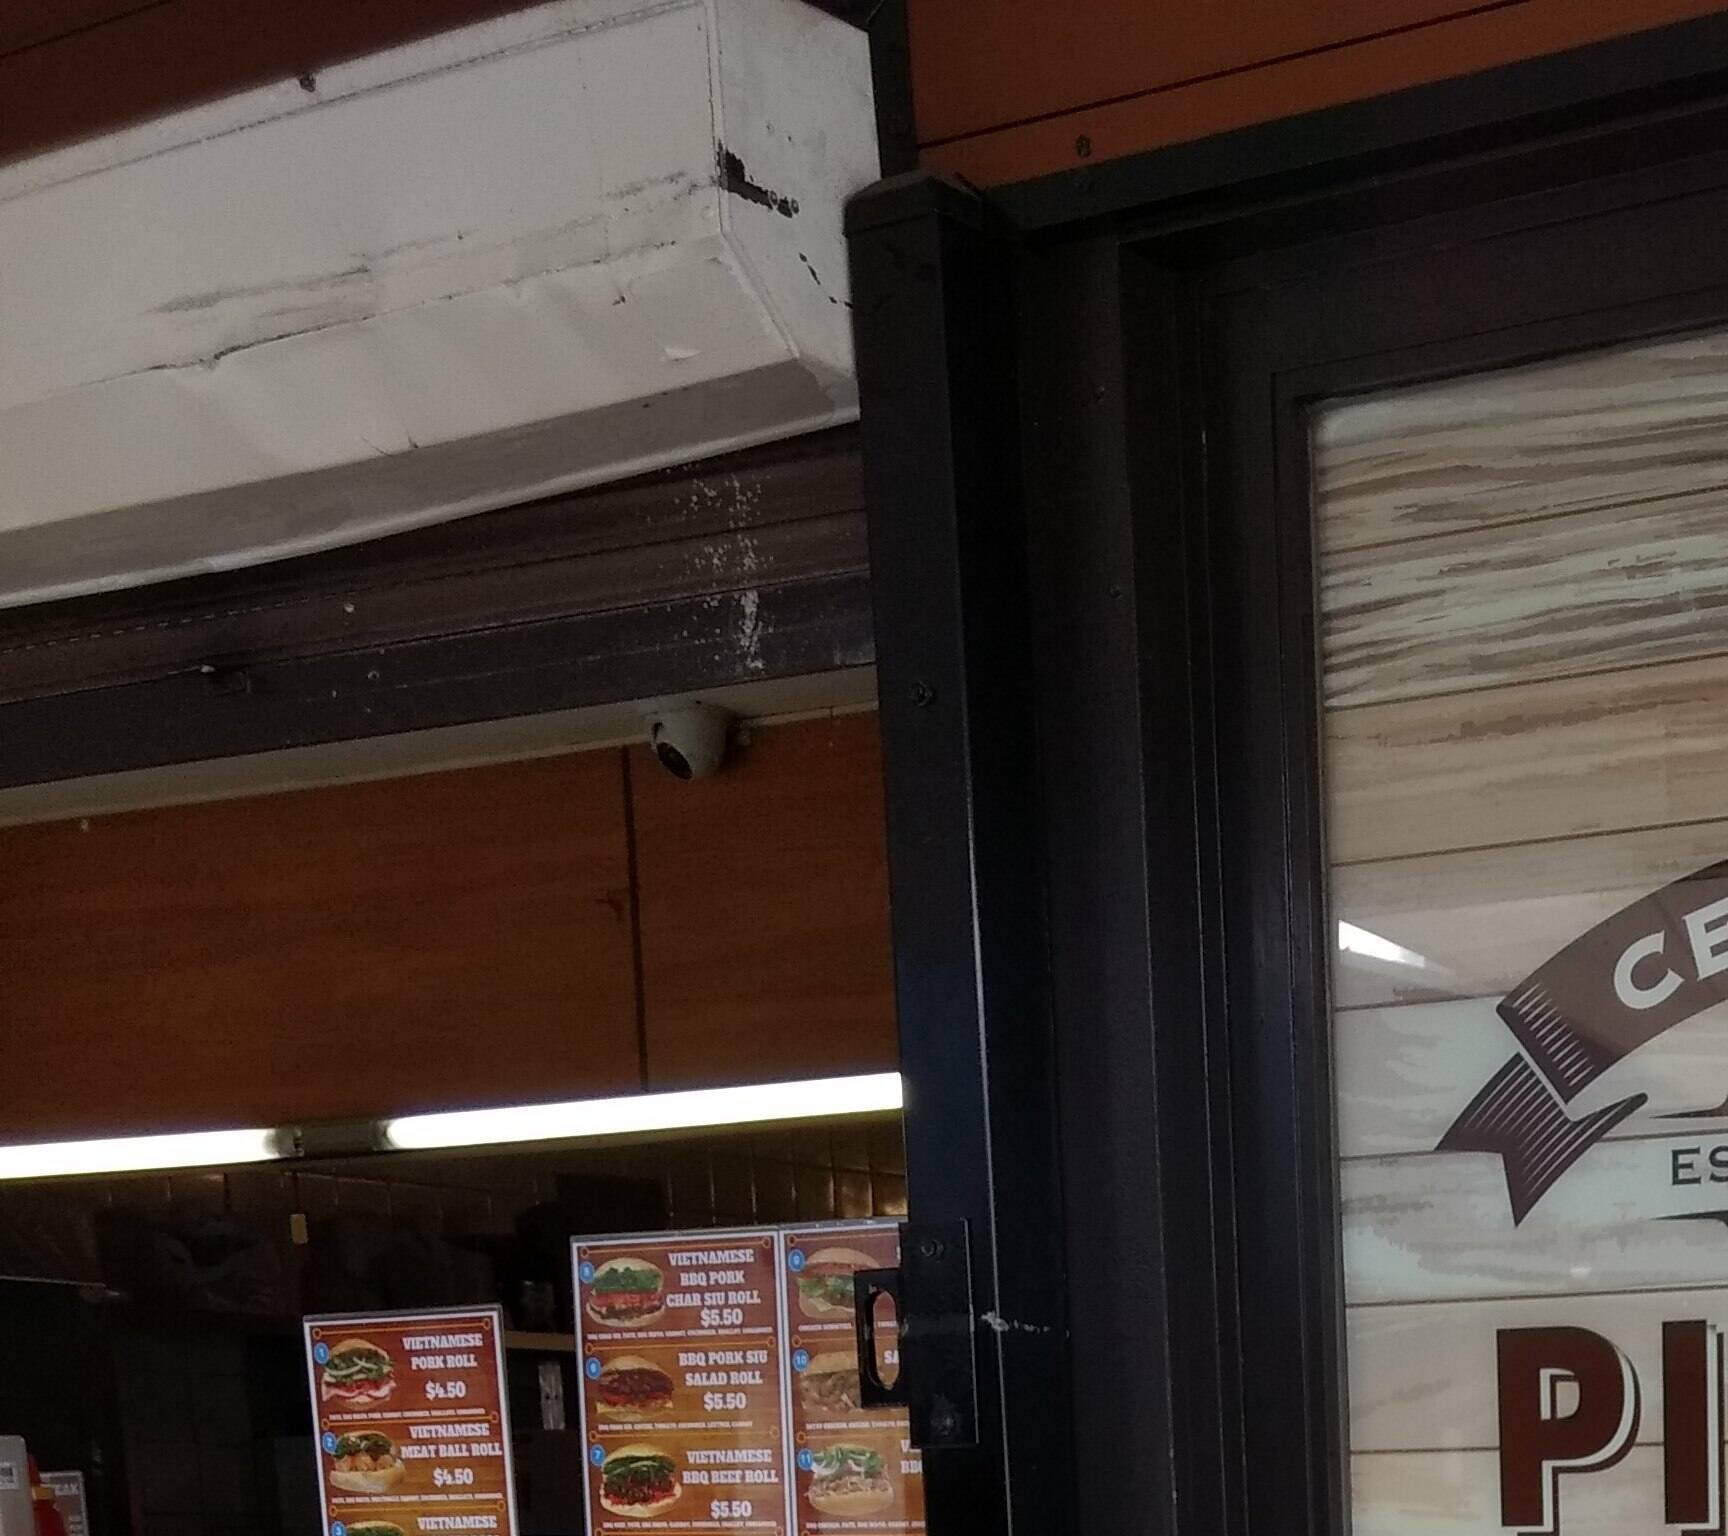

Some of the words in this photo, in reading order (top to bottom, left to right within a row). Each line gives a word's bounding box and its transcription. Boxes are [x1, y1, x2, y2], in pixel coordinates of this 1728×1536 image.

[668, 1249, 754, 1266] VIETNAMESE
[680, 1272, 706, 1287] BBQ
[709, 1270, 745, 1285] PORK
[666, 1293, 701, 1308] CHAR
[704, 1292, 725, 1306] SIU
[727, 1290, 761, 1304] ROLL
[700, 1308, 743, 1328] $5.50
[403, 1333, 483, 1350] VIETNAMESE
[411, 1356, 444, 1370] PORK
[447, 1354, 477, 1368] ROLL
[425, 1381, 466, 1400] $4.50
[686, 1449, 772, 1465] VIETNAMESE
[683, 1470, 709, 1485] BBQ
[711, 1470, 743, 1484] BEEF
[745, 1469, 779, 1483] ROLL
[710, 1500, 752, 1519] $5.50
[416, 1515, 497, 1530] VIETNAMESE
